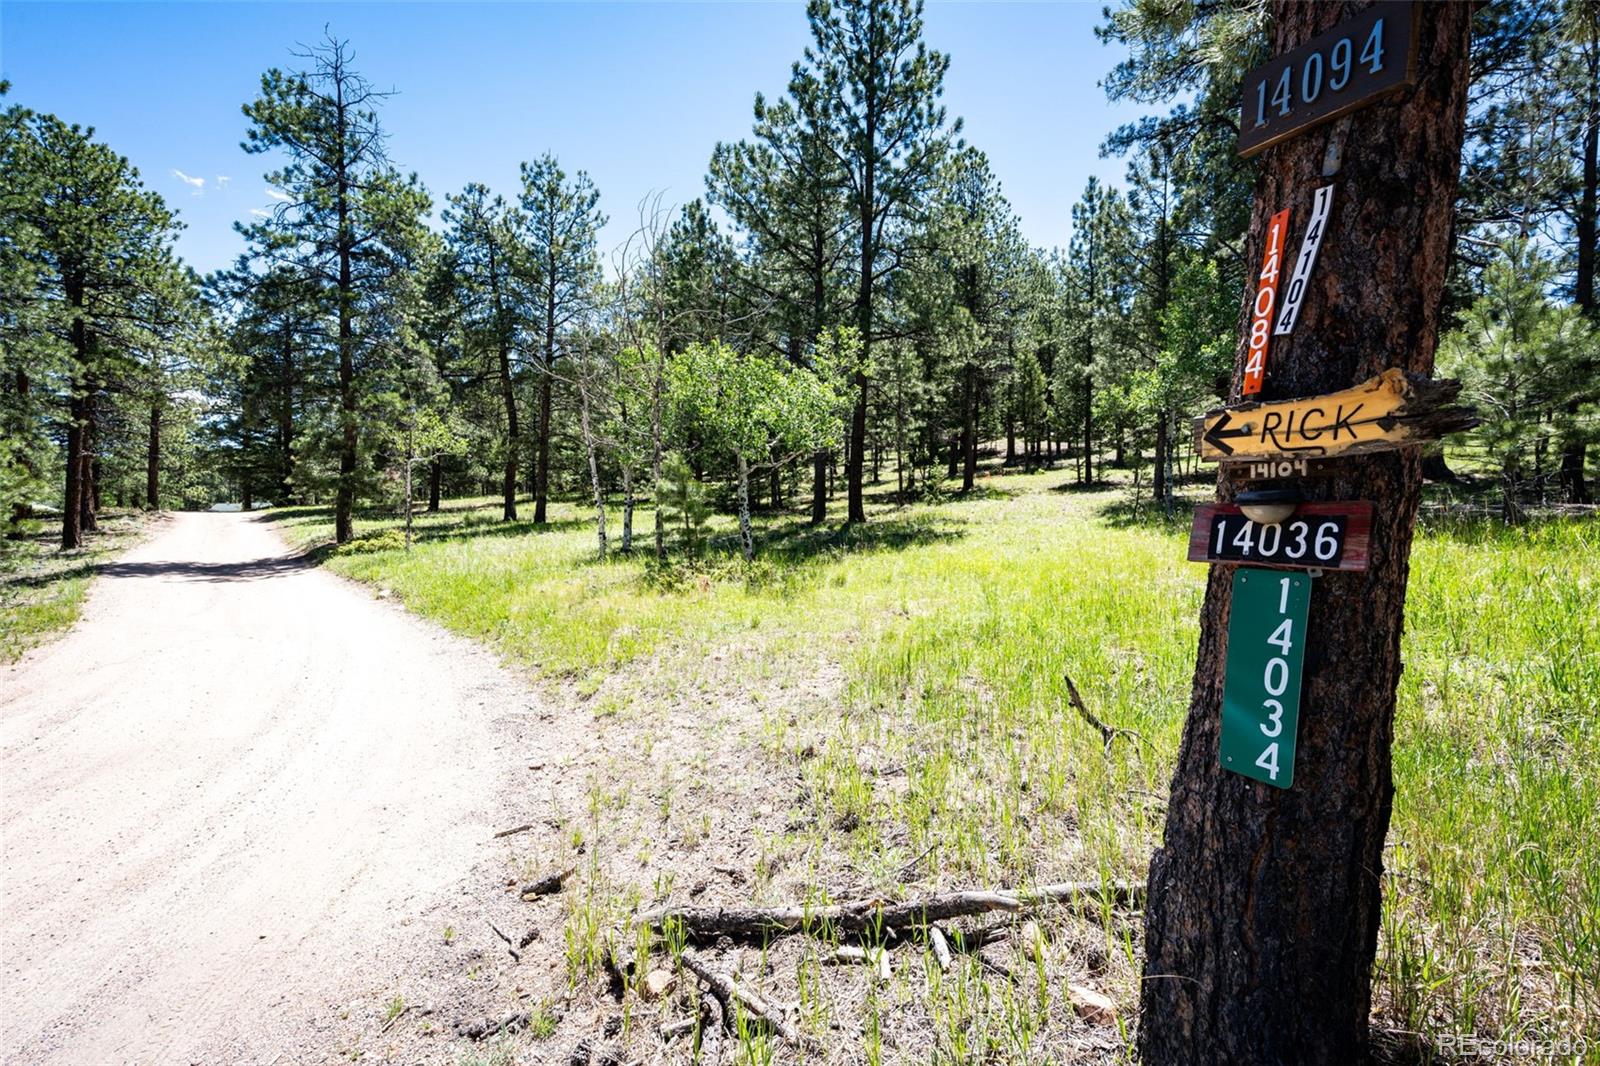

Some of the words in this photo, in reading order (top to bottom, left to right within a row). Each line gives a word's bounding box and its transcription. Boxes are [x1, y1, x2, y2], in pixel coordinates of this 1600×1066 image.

[1255, 18, 1385, 128] 14094
[1245, 223, 1280, 379] 14084
[1279, 188, 1329, 332] 14104
[1250, 460, 1308, 479] 14104
[1260, 403, 1364, 455] RICK
[1216, 520, 1339, 561] 14036
[1255, 577, 1293, 781] 14034
